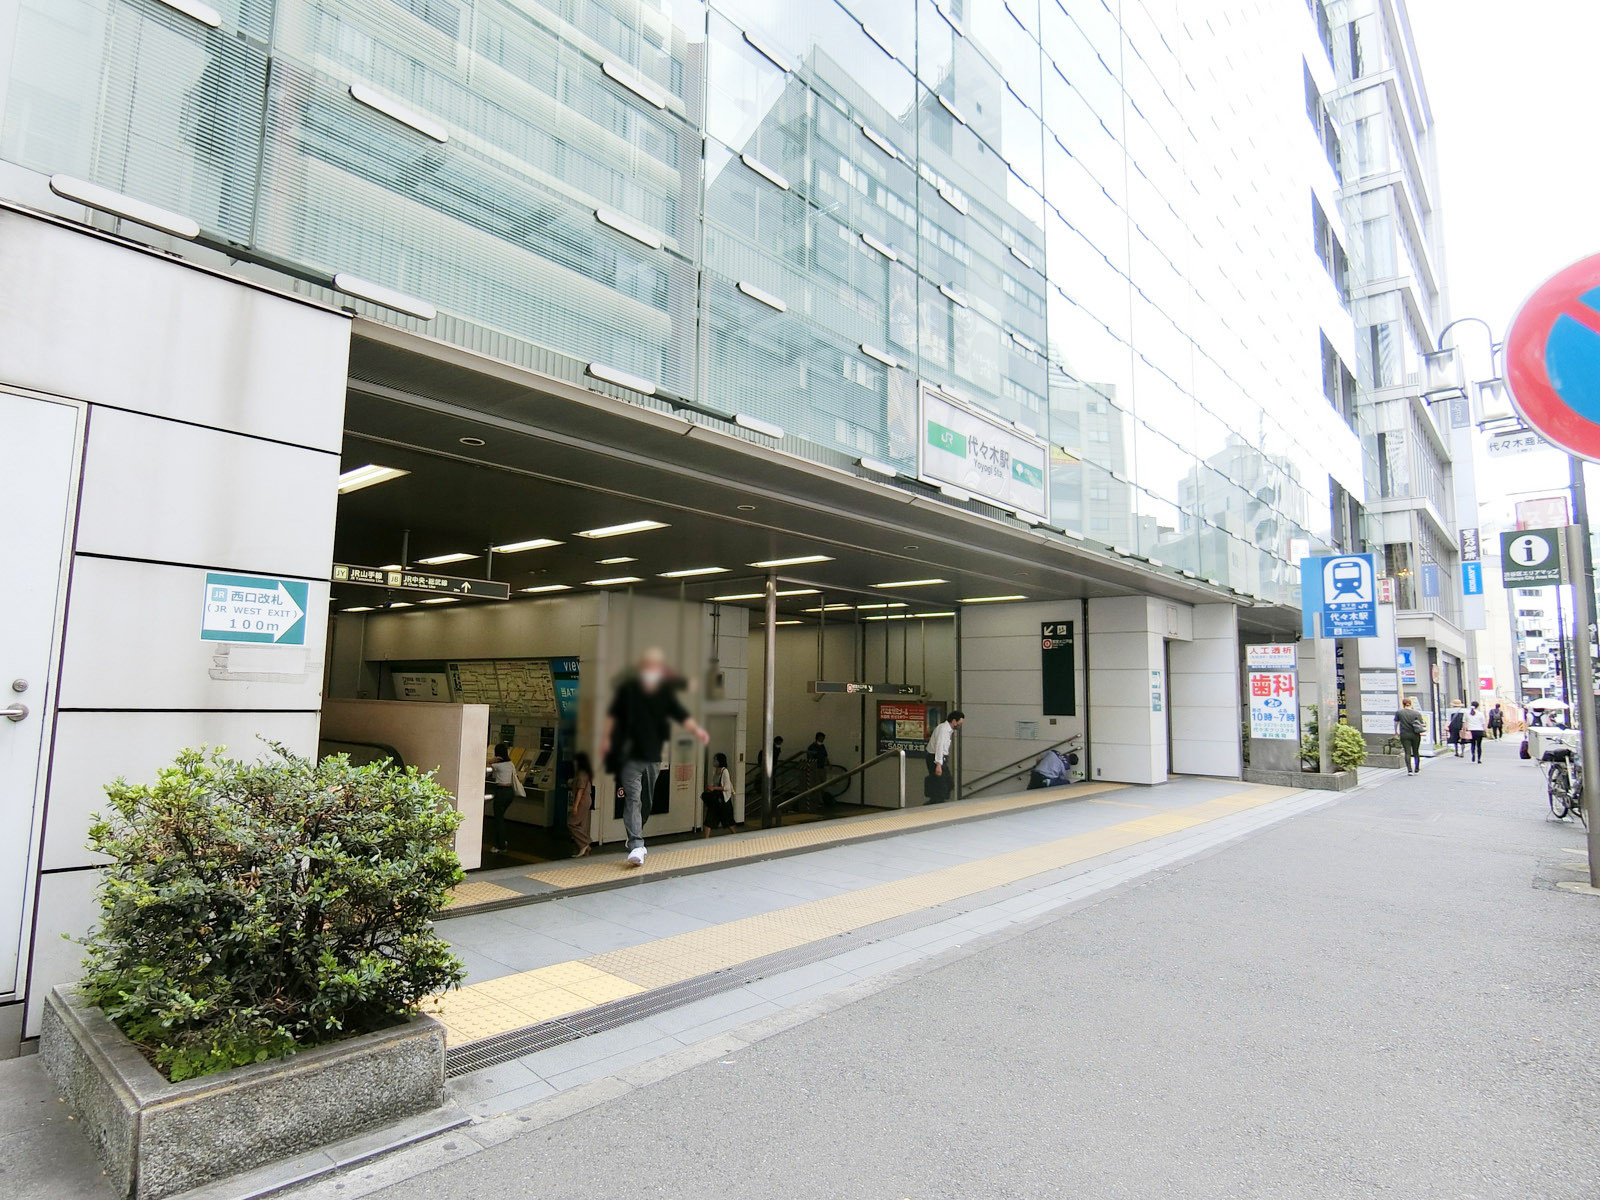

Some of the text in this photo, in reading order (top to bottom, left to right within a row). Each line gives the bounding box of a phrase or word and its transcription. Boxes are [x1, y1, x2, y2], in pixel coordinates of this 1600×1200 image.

[941, 431, 953, 446] JR
[968, 434, 1010, 470] 代々木駅
[974, 458, 993, 476] Yoyogi
[993, 465, 1005, 479] Sta.
[350, 569, 383, 580] JR山手線
[213, 590, 283, 606] JR 西口改札
[233, 606, 262, 616] WEST
[1330, 612, 1369, 621] 代々木駅
[1249, 646, 1292, 655] 人工透析
[1251, 674, 1294, 697] 歯科
